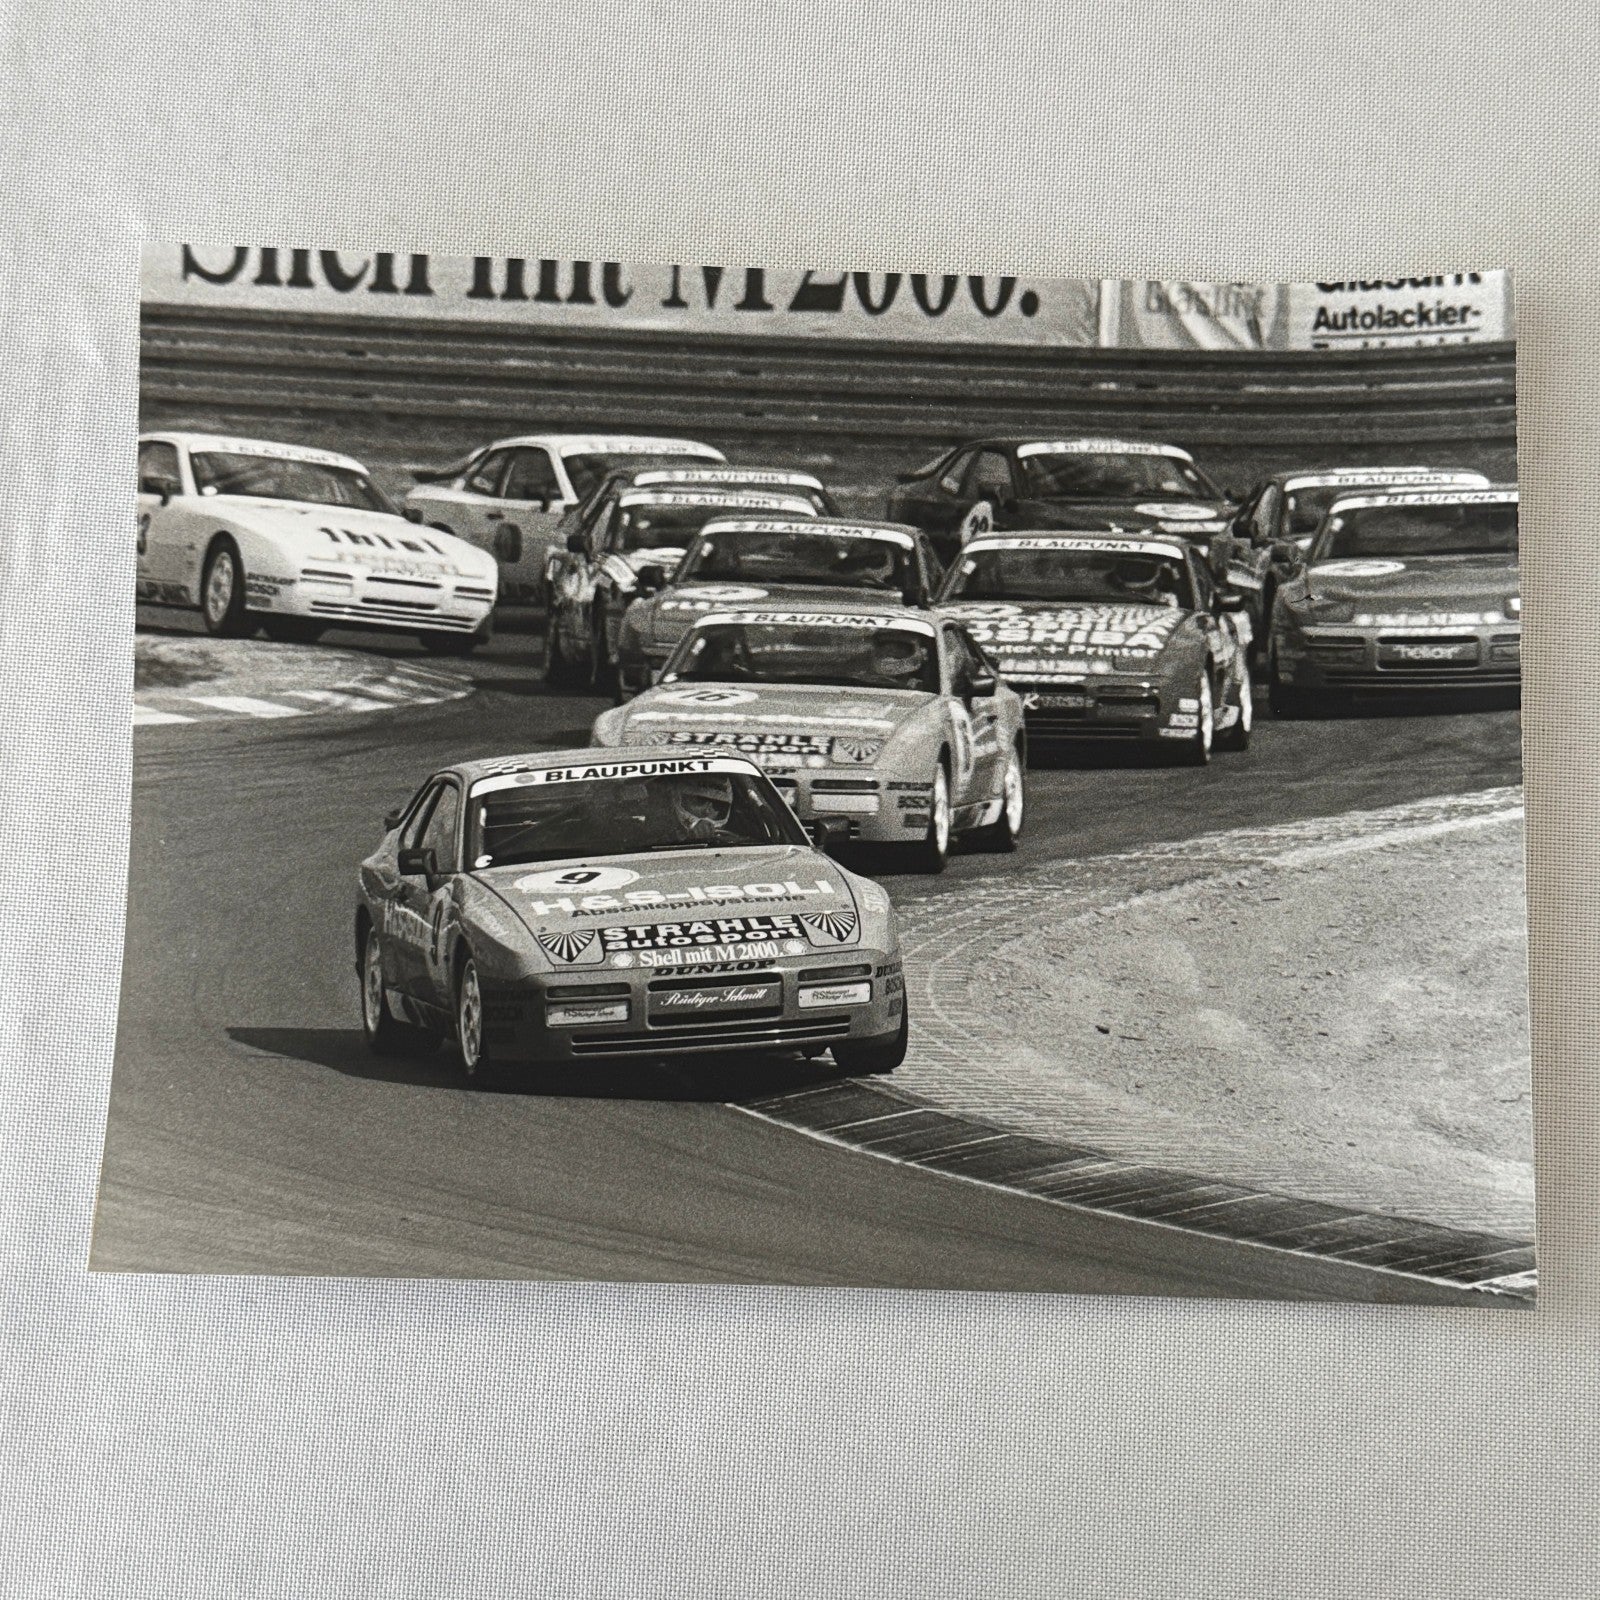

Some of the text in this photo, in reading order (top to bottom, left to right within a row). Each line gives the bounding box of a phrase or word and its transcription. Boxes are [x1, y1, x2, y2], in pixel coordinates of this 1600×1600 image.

[1312, 300, 1482, 332] Autolackier-
[685, 472, 790, 483] BLAUPUNKT
[1338, 474, 1455, 484] BLAUPUNKT
[672, 496, 783, 508] BLAUPUNKT
[1386, 492, 1513, 504] BLAUPUNKT
[755, 523, 882, 537] BLAUPUNKT
[1018, 540, 1146, 552] BLAUPUNKT
[753, 613, 896, 628] BLAUPUNKT
[967, 628, 1165, 650] OSHIBA
[1068, 644, 1158, 658] Printer
[679, 690, 740, 702] 16
[545, 760, 714, 782] BLAUPUNKT
[555, 871, 602, 885] 9
[571, 894, 807, 918] Abschleppsysteme
[603, 915, 798, 941] STRÄHLE
[605, 927, 803, 951] autosport
[639, 950, 681, 967] Shell
[685, 947, 712, 963] mit
[652, 960, 775, 977] DUNLOP
[660, 992, 719, 1008] Rüdiger
